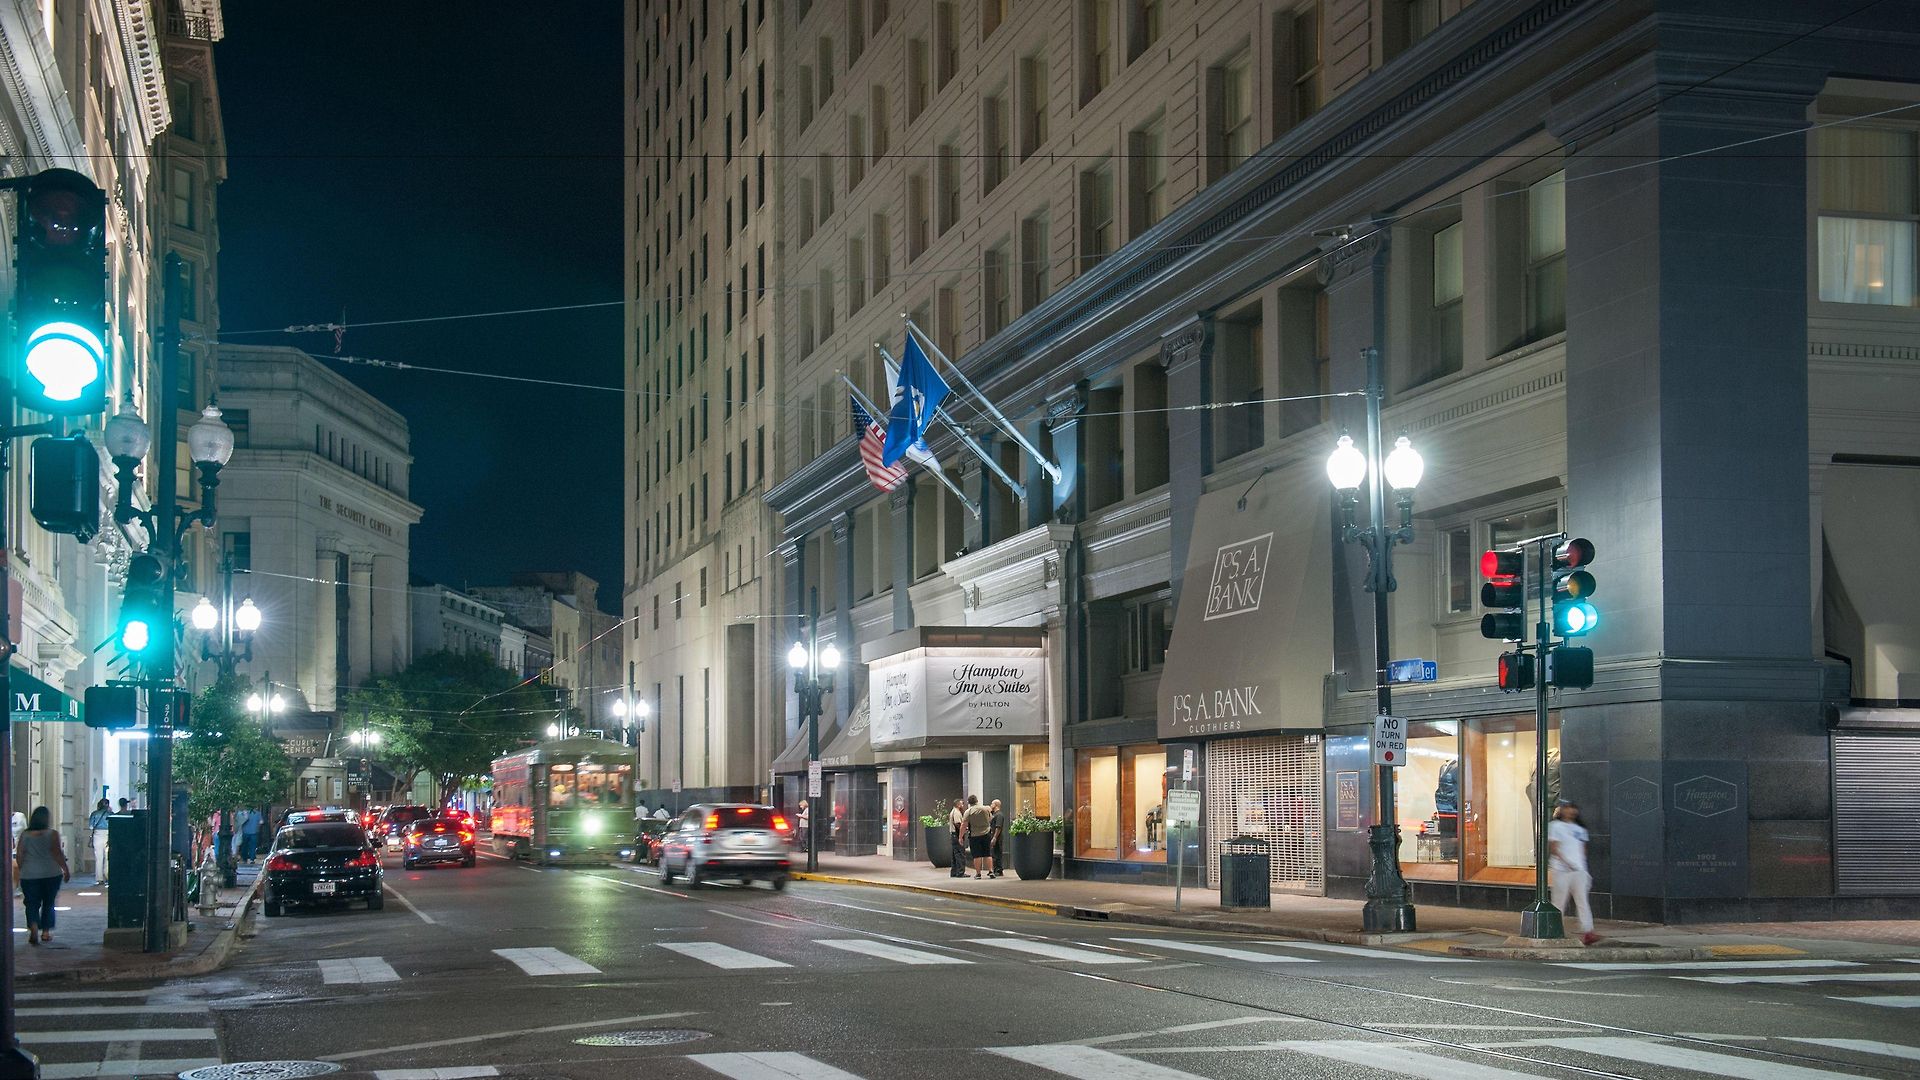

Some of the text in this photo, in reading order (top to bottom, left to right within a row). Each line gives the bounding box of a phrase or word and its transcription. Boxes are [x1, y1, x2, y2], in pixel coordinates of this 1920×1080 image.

[319, 495, 392, 537] THE SECURITY CENTER
[1209, 575, 1260, 614] BANK
[952, 663, 1025, 681] Hampton
[948, 680, 1031, 696] Inn & Suites
[1214, 685, 1262, 719] BANK
[976, 716, 1003, 730] 226
[1189, 720, 1241, 734] CLOTHIERS
[1383, 718, 1399, 729] NO
[1381, 730, 1401, 740] TURN
[1376, 740, 1404, 750] ON RED
